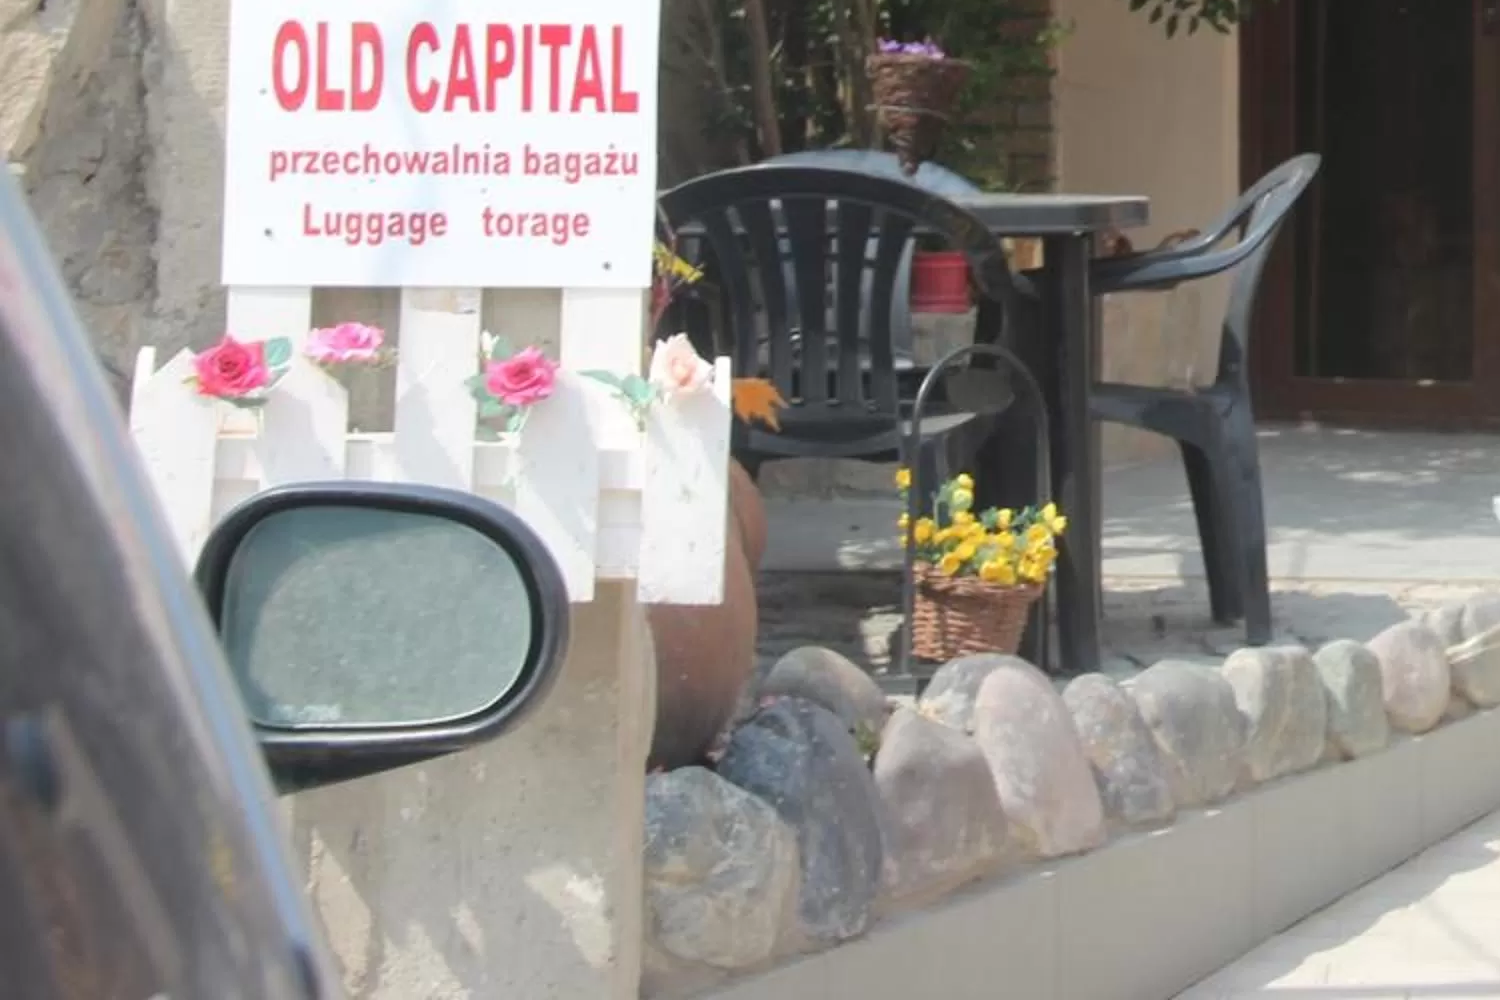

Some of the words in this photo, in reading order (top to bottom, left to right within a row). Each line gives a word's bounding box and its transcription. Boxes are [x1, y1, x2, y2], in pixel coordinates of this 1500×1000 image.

[272, 19, 385, 113] OLD
[405, 21, 641, 114] CAPITAL
[269, 143, 511, 182] przechowalnia
[522, 142, 640, 185] bagażu
[302, 203, 449, 247] Luggage
[481, 205, 591, 247] torage
